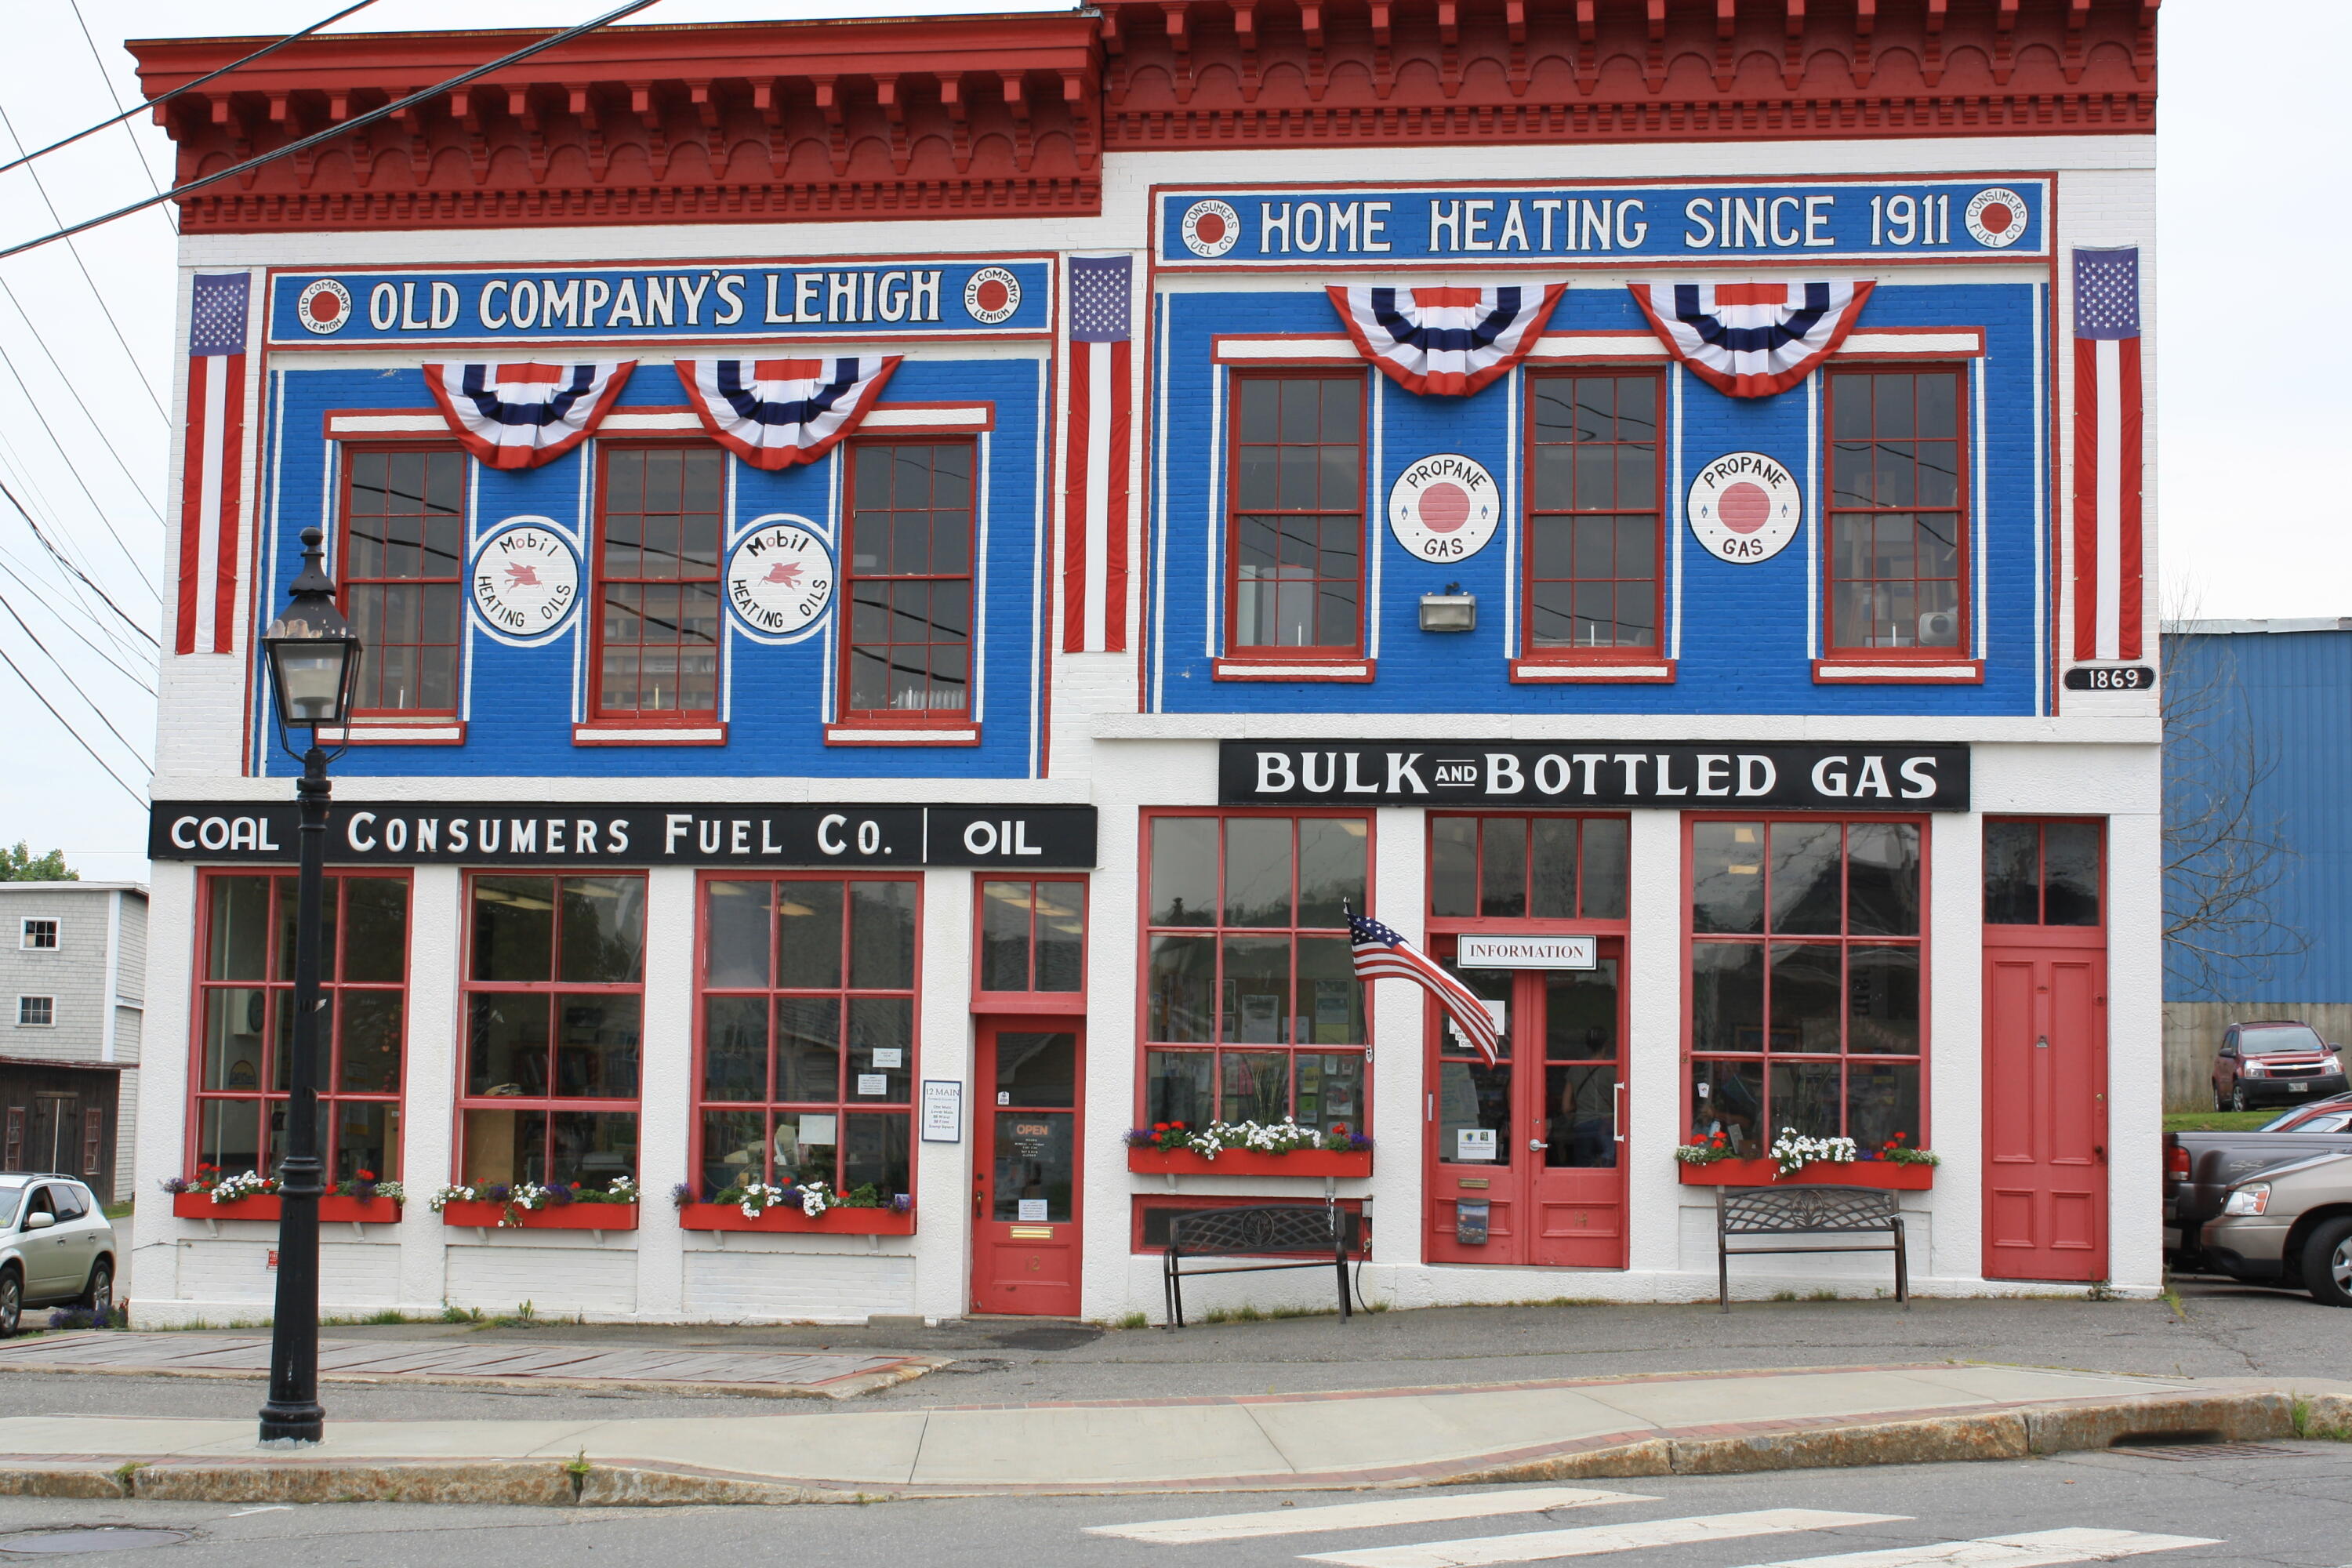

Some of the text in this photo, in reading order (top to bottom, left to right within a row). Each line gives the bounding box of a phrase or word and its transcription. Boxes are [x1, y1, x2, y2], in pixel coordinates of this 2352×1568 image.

[1185, 201, 1238, 229] CONSUMERS
[1968, 191, 2025, 219] CONSUMERS
[1259, 194, 1950, 254] HOME HEATING SINCE 1911
[1969, 223, 1998, 246] FUEL
[1185, 234, 1212, 255] FUEL
[301, 298, 310, 316] OLD
[369, 270, 943, 331] OLD COMPANY'S LEHIGH
[967, 284, 976, 304] OLD
[307, 318, 342, 332] LEHIGH
[974, 308, 1010, 321] LEHIGH
[1406, 459, 1486, 492] PROPANE
[1704, 456, 1787, 489] PROPANE
[499, 533, 558, 557] Mobil
[746, 530, 809, 557] Mobil
[1424, 538, 1464, 557] GAS
[1722, 539, 1763, 557] GAS
[478, 576, 571, 627] HEATING OILS
[732, 579, 827, 628] HEATING OILS
[2089, 669, 2139, 688] 1869
[1254, 752, 1937, 798] BULK AND BOTTLED GAS
[171, 816, 279, 851] COAL
[347, 811, 892, 855] CONSUMERS FUEL CO.
[964, 820, 1042, 855] OIL
[1470, 944, 1584, 959] INFORMATION
[1016, 1124, 1048, 1135] OPEN
